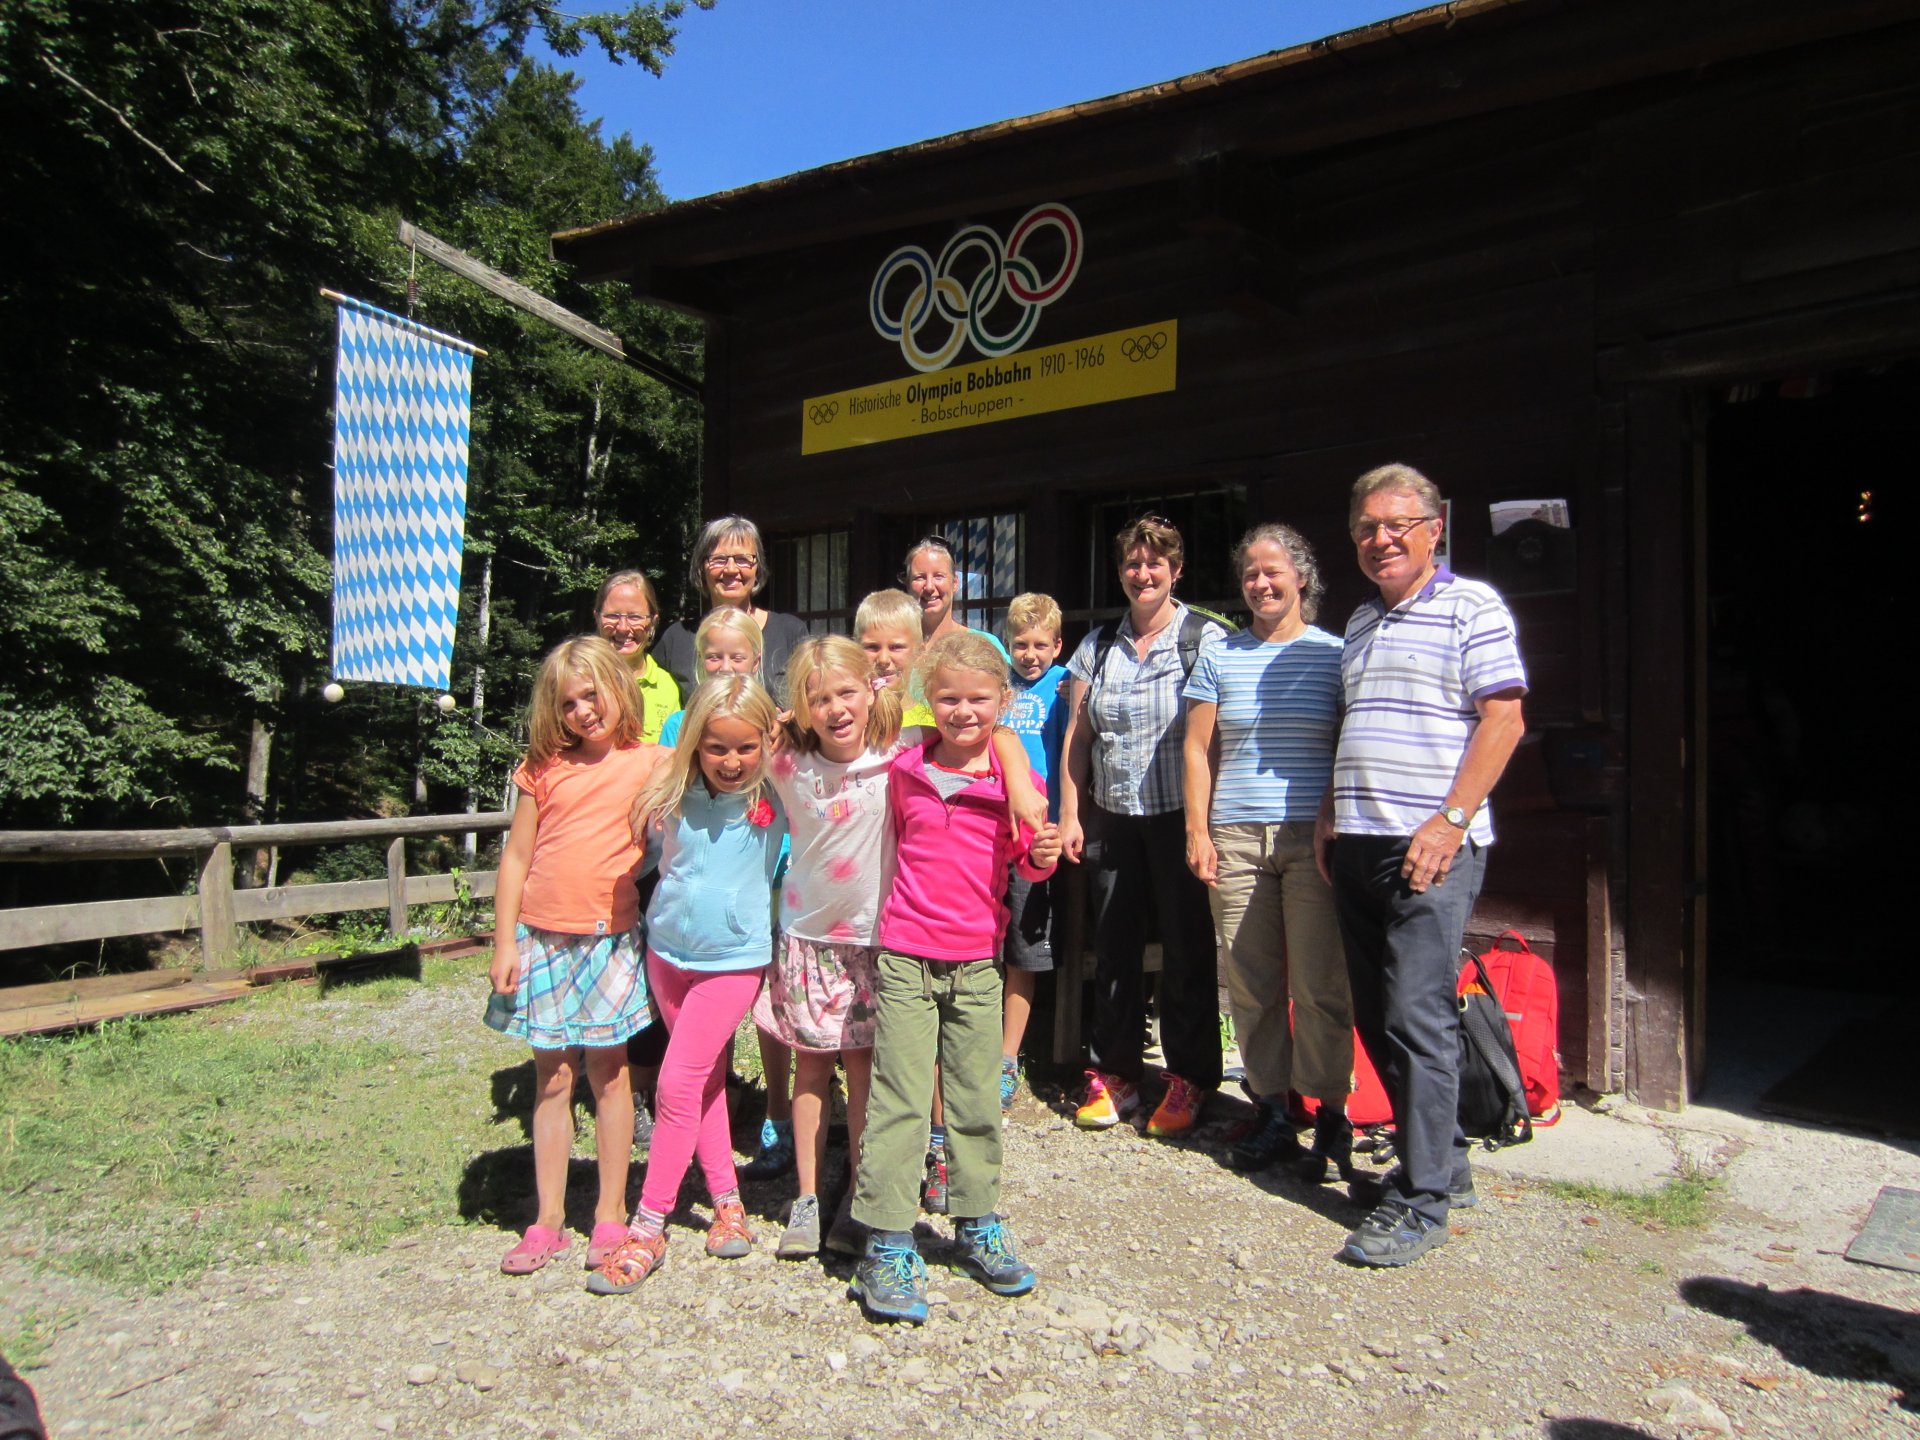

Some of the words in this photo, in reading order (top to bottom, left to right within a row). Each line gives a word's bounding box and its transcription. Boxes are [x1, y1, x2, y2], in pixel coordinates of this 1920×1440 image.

[849, 388, 902, 416] Historische
[906, 377, 962, 406] Olympia
[967, 362, 1032, 393] Bobbahn
[921, 394, 1013, 424] Bobschuppen
[1009, 709, 1034, 719] 167
[1012, 692, 1046, 719] RADEMARK
[1013, 702, 1035, 710] SINCE
